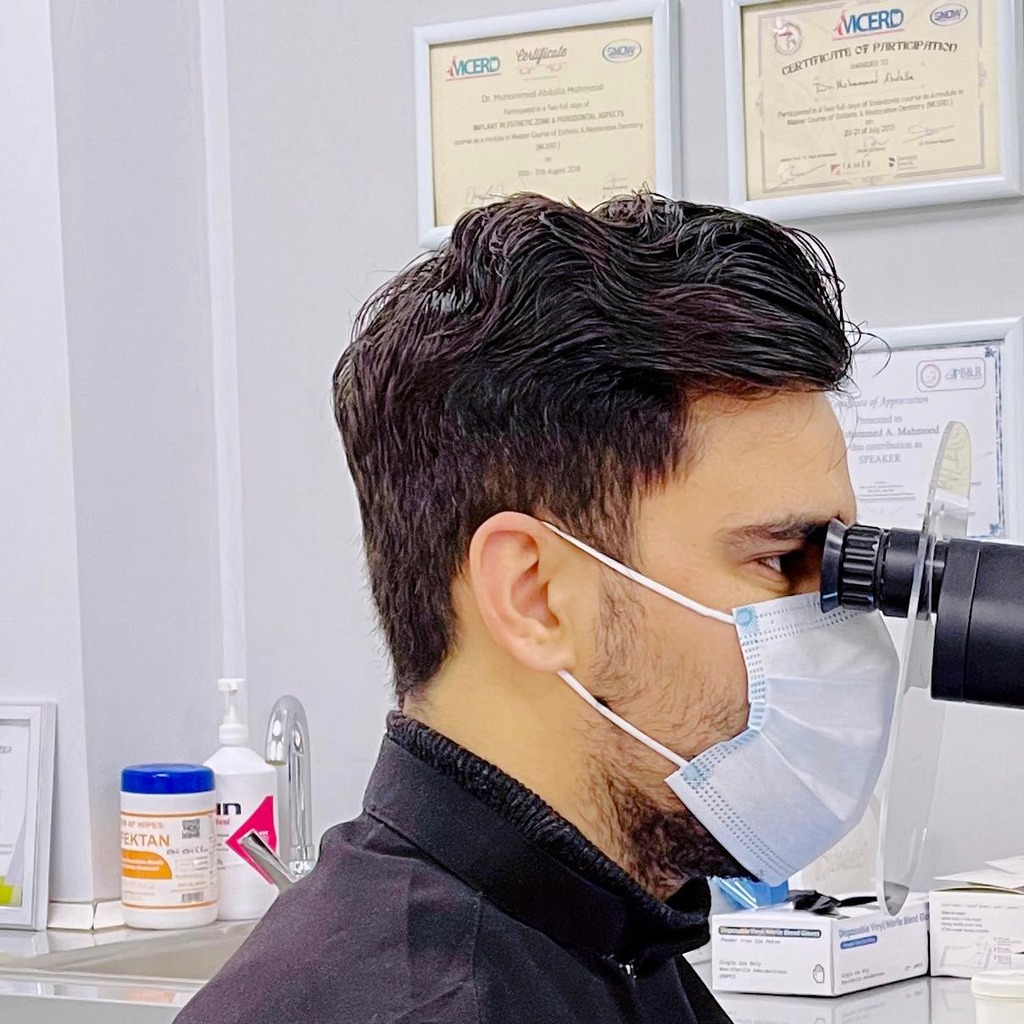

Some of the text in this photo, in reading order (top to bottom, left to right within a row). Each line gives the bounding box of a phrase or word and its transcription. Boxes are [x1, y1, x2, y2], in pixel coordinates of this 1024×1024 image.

[515, 44, 568, 65] Certificate
[781, 40, 959, 76] CERTIFICATE OF PARTICIPATION
